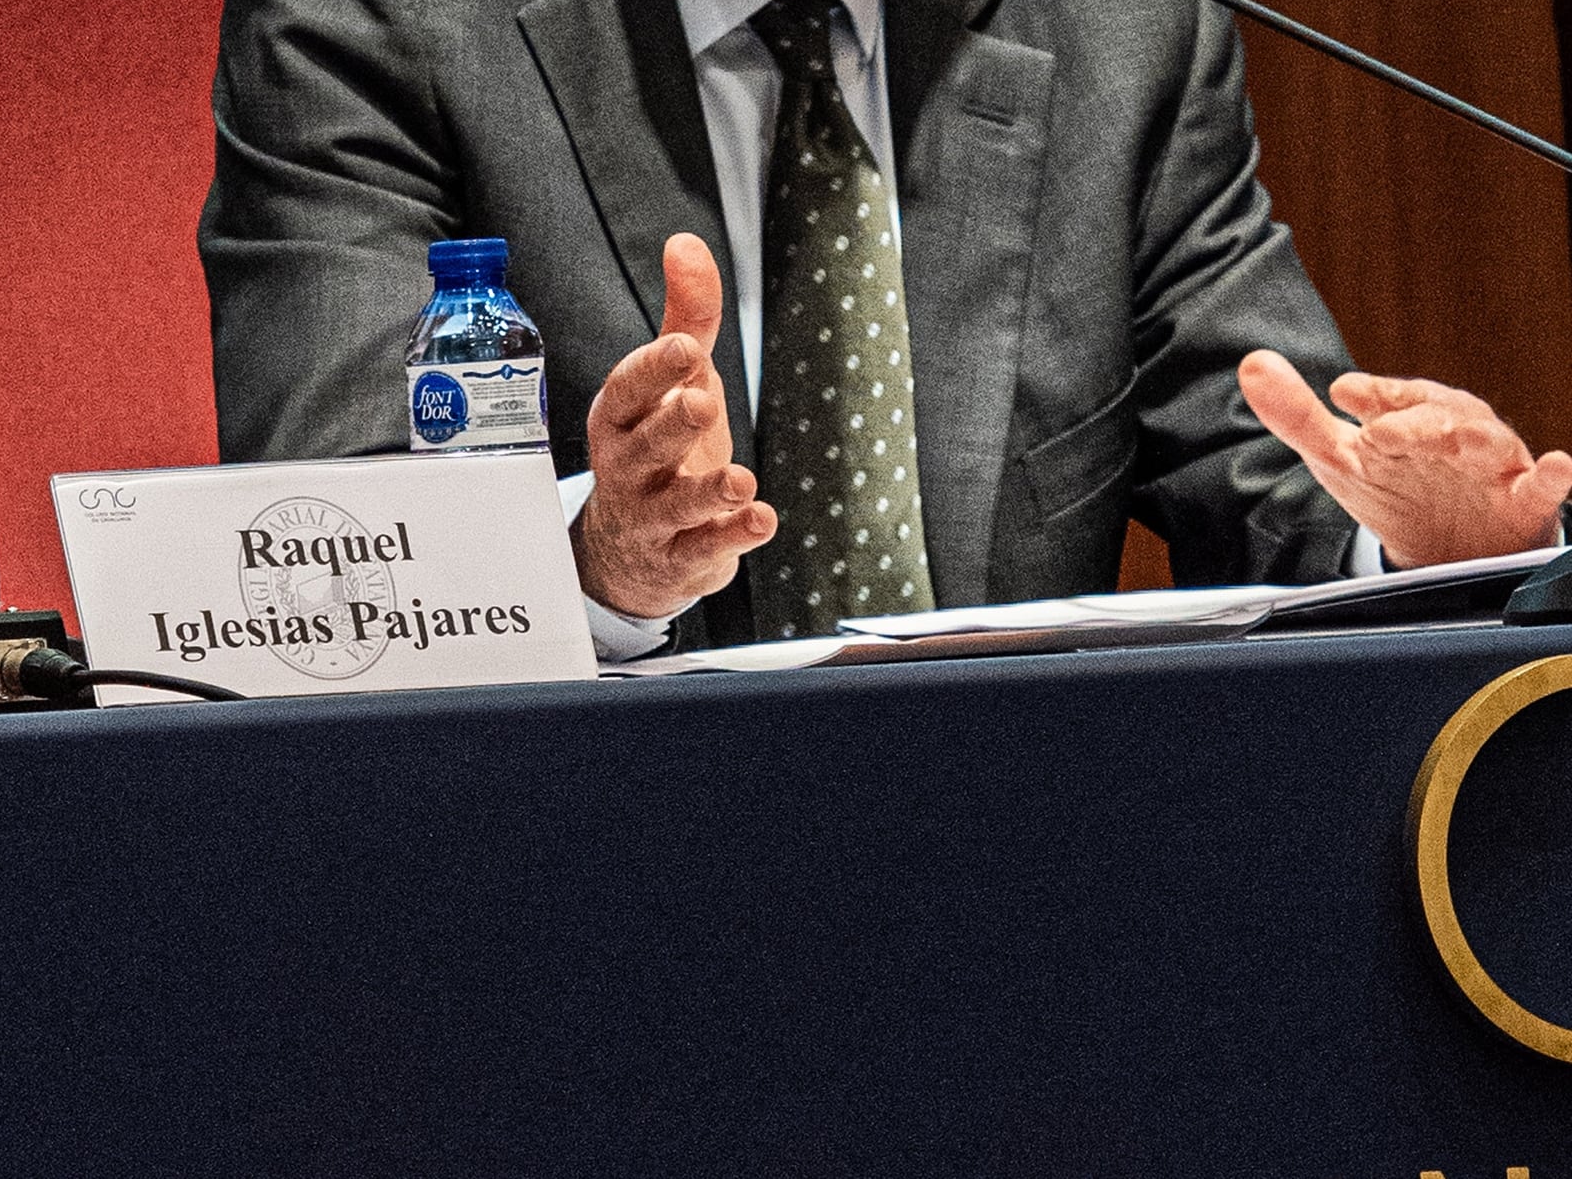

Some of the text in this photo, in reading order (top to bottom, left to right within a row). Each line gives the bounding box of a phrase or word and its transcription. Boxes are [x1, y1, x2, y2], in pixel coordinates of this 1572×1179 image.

[237, 522, 414, 577] Raquel
[150, 598, 532, 662] Iglesias Pajares
